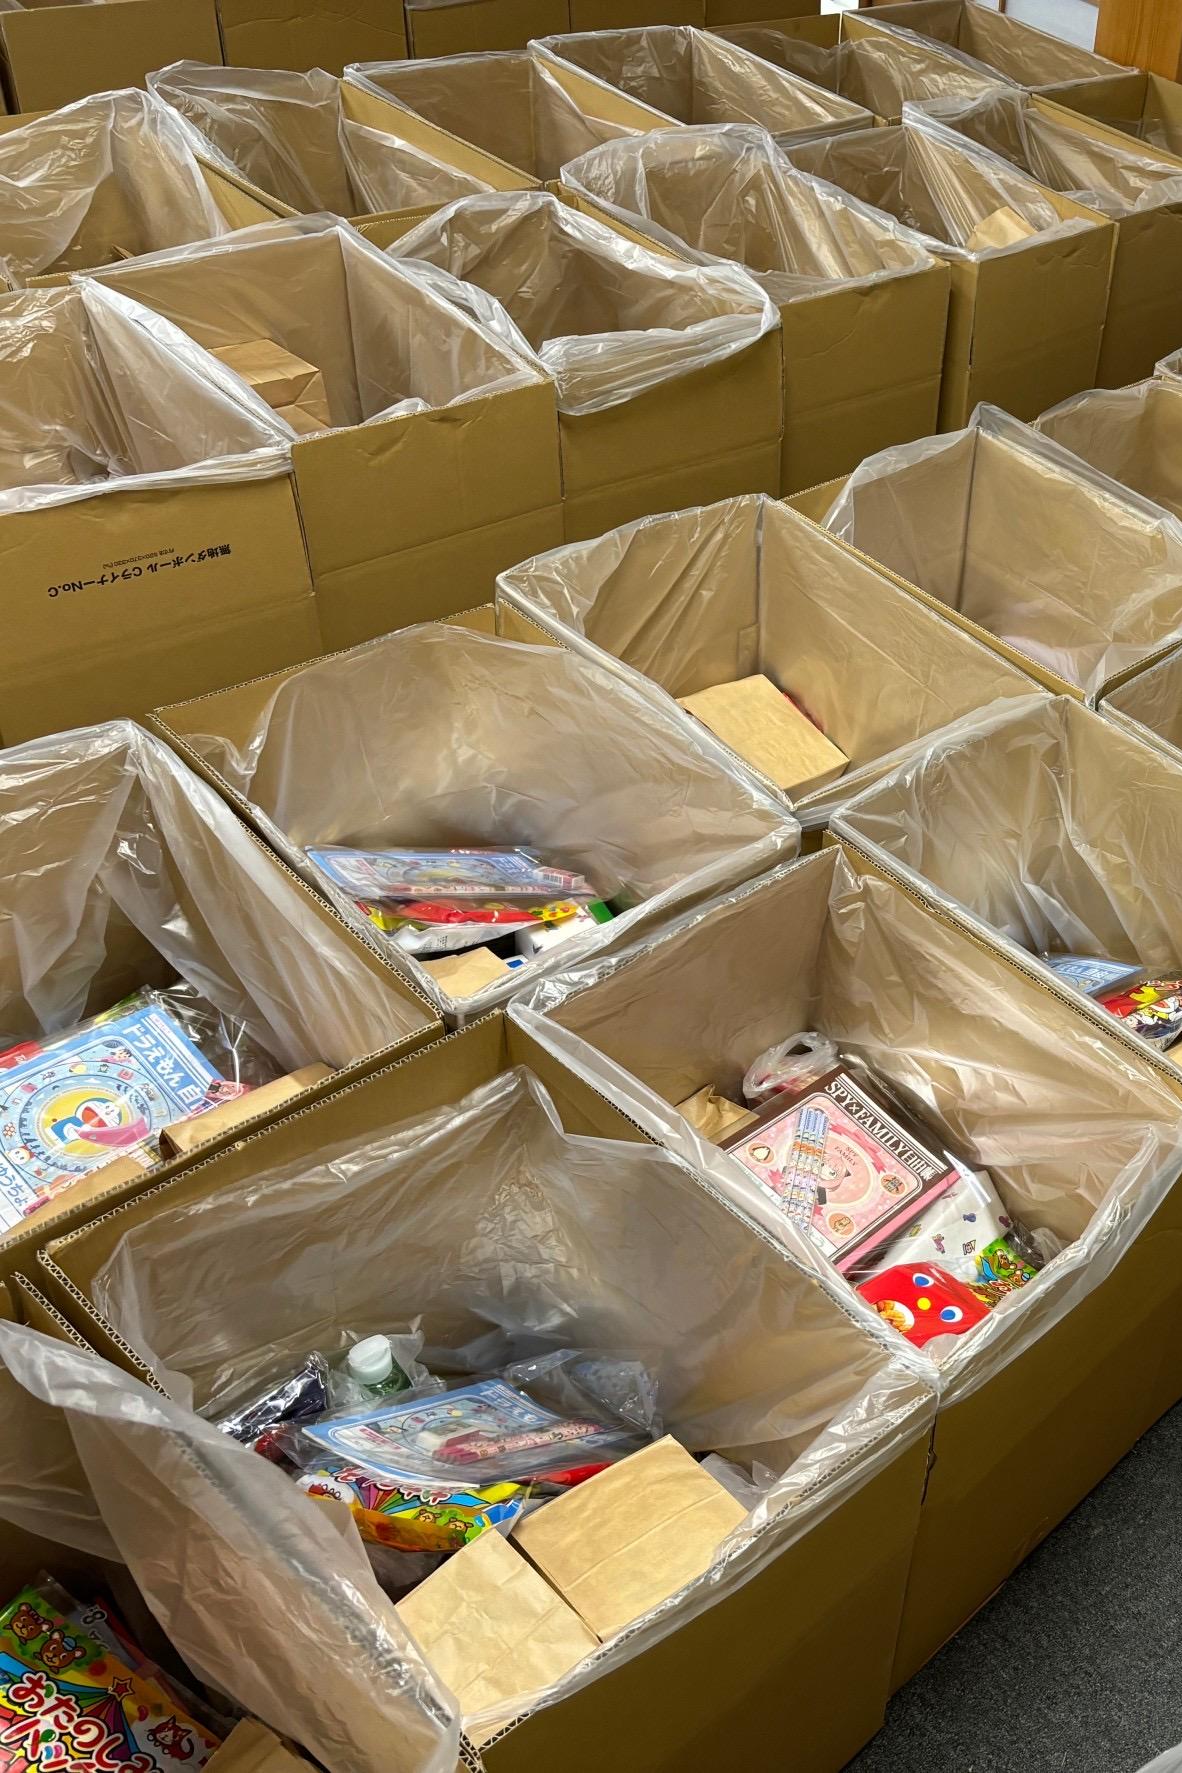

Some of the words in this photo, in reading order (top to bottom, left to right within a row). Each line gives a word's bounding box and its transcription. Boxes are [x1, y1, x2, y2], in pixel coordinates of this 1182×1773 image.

[147, 543, 232, 573] 無地ダンボール
[122, 1023, 185, 1088] ドラえもん
